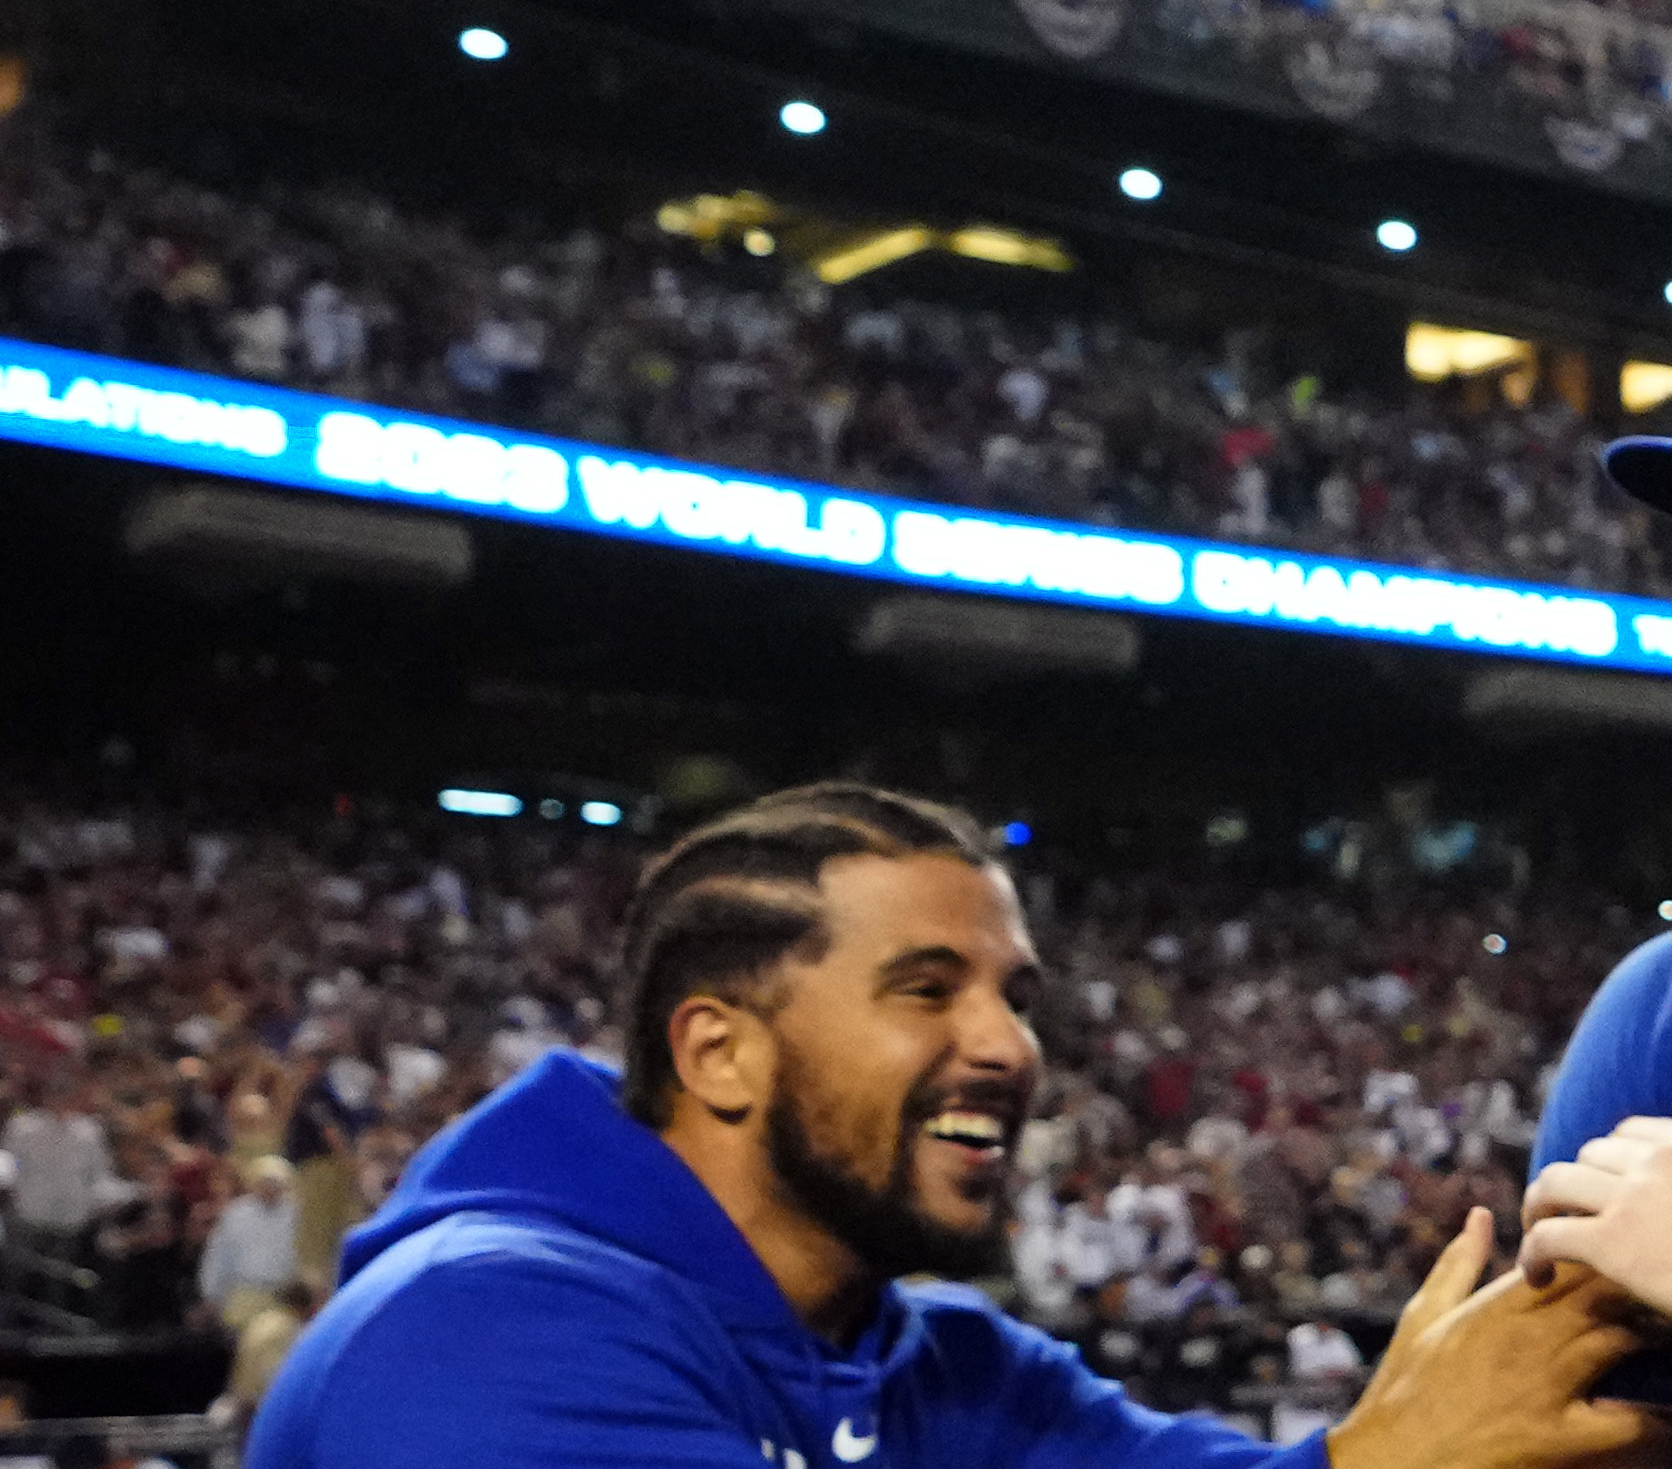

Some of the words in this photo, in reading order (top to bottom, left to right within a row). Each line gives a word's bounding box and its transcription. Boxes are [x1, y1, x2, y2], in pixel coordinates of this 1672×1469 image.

[578, 457, 885, 564] WORLD
[894, 511, 1183, 604] SERIES
[1193, 552, 1617, 656] CHAMPIONS
